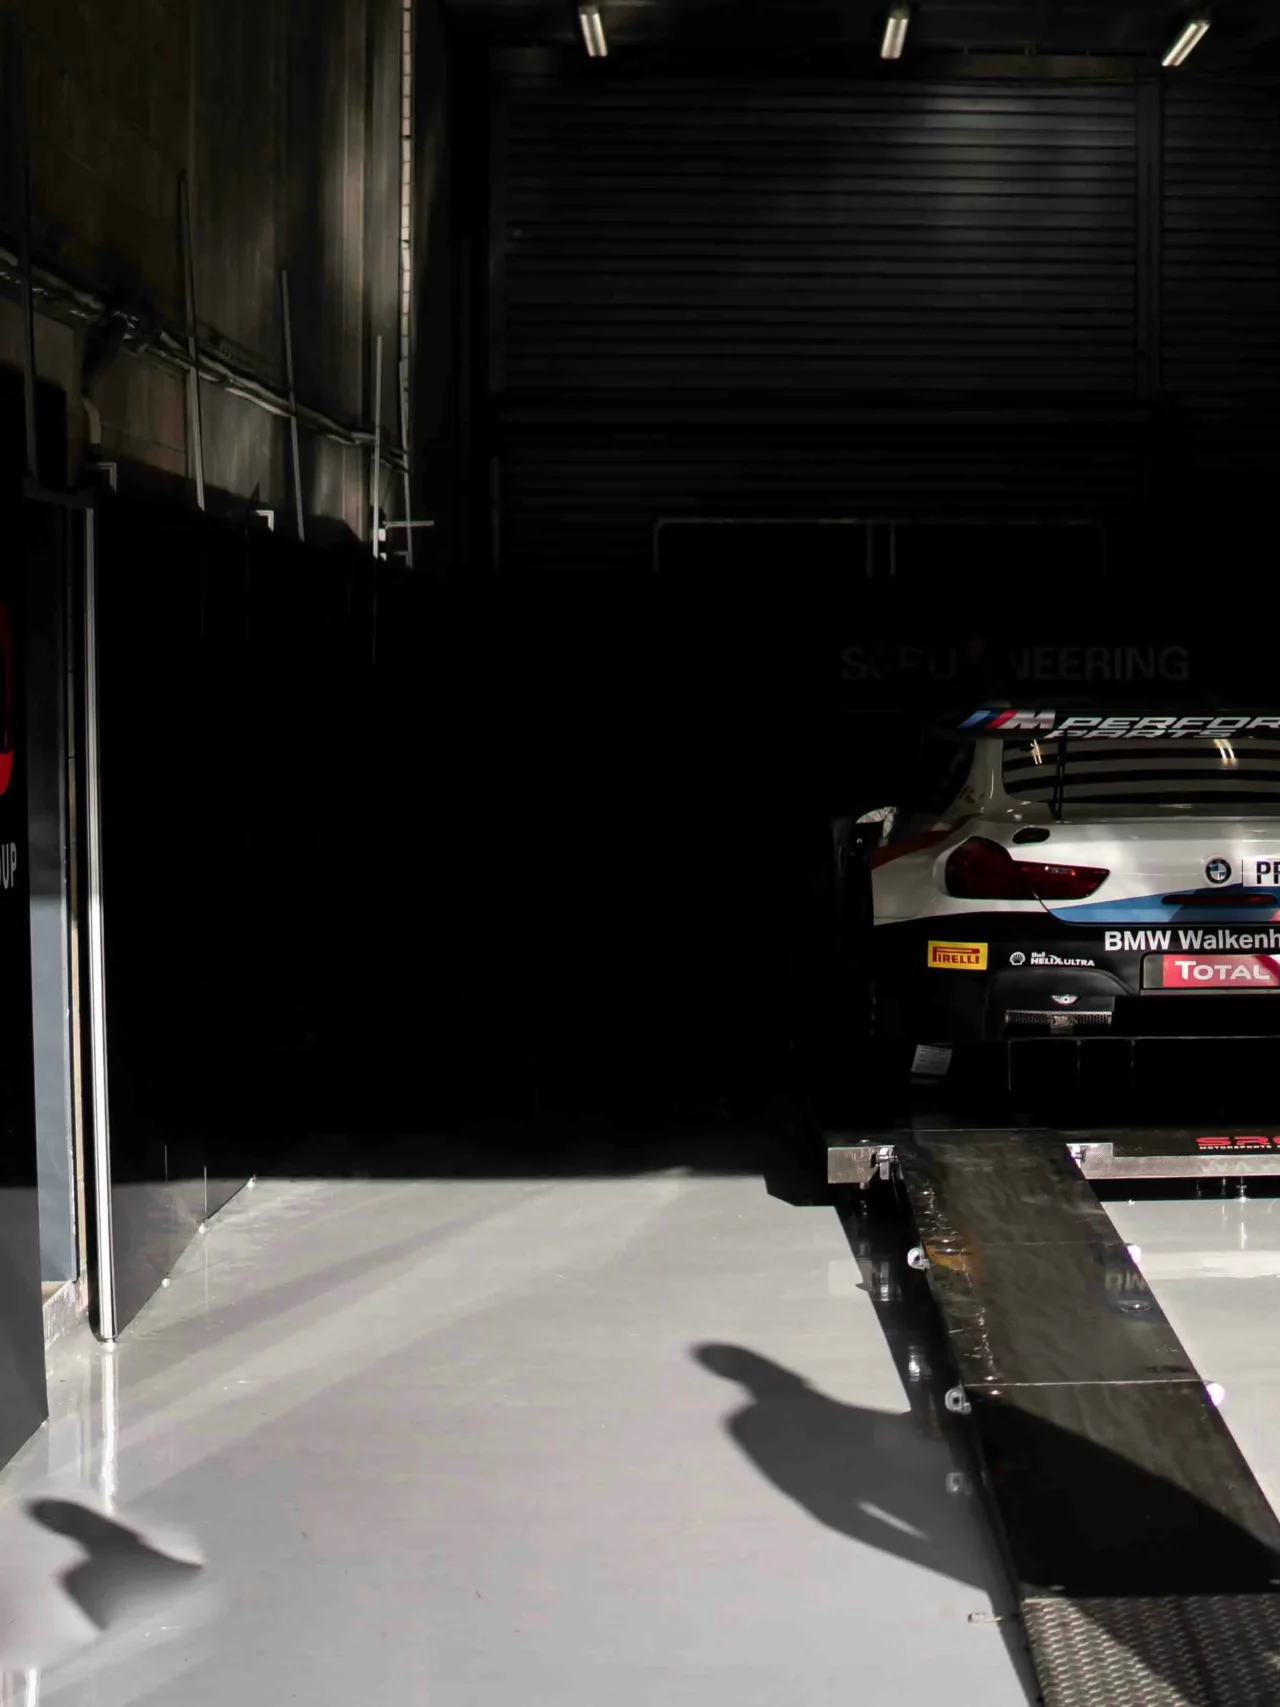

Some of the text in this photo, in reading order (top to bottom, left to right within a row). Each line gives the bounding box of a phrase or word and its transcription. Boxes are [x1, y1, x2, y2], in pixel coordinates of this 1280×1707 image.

[1044, 729, 1237, 739] PARTS
[0, 842, 18, 890] UP
[1104, 931, 1171, 951] BMW
[932, 946, 980, 964] PIRELLI
[1062, 958, 1095, 966] ULTRA
[1174, 961, 1270, 980] TOTAL
